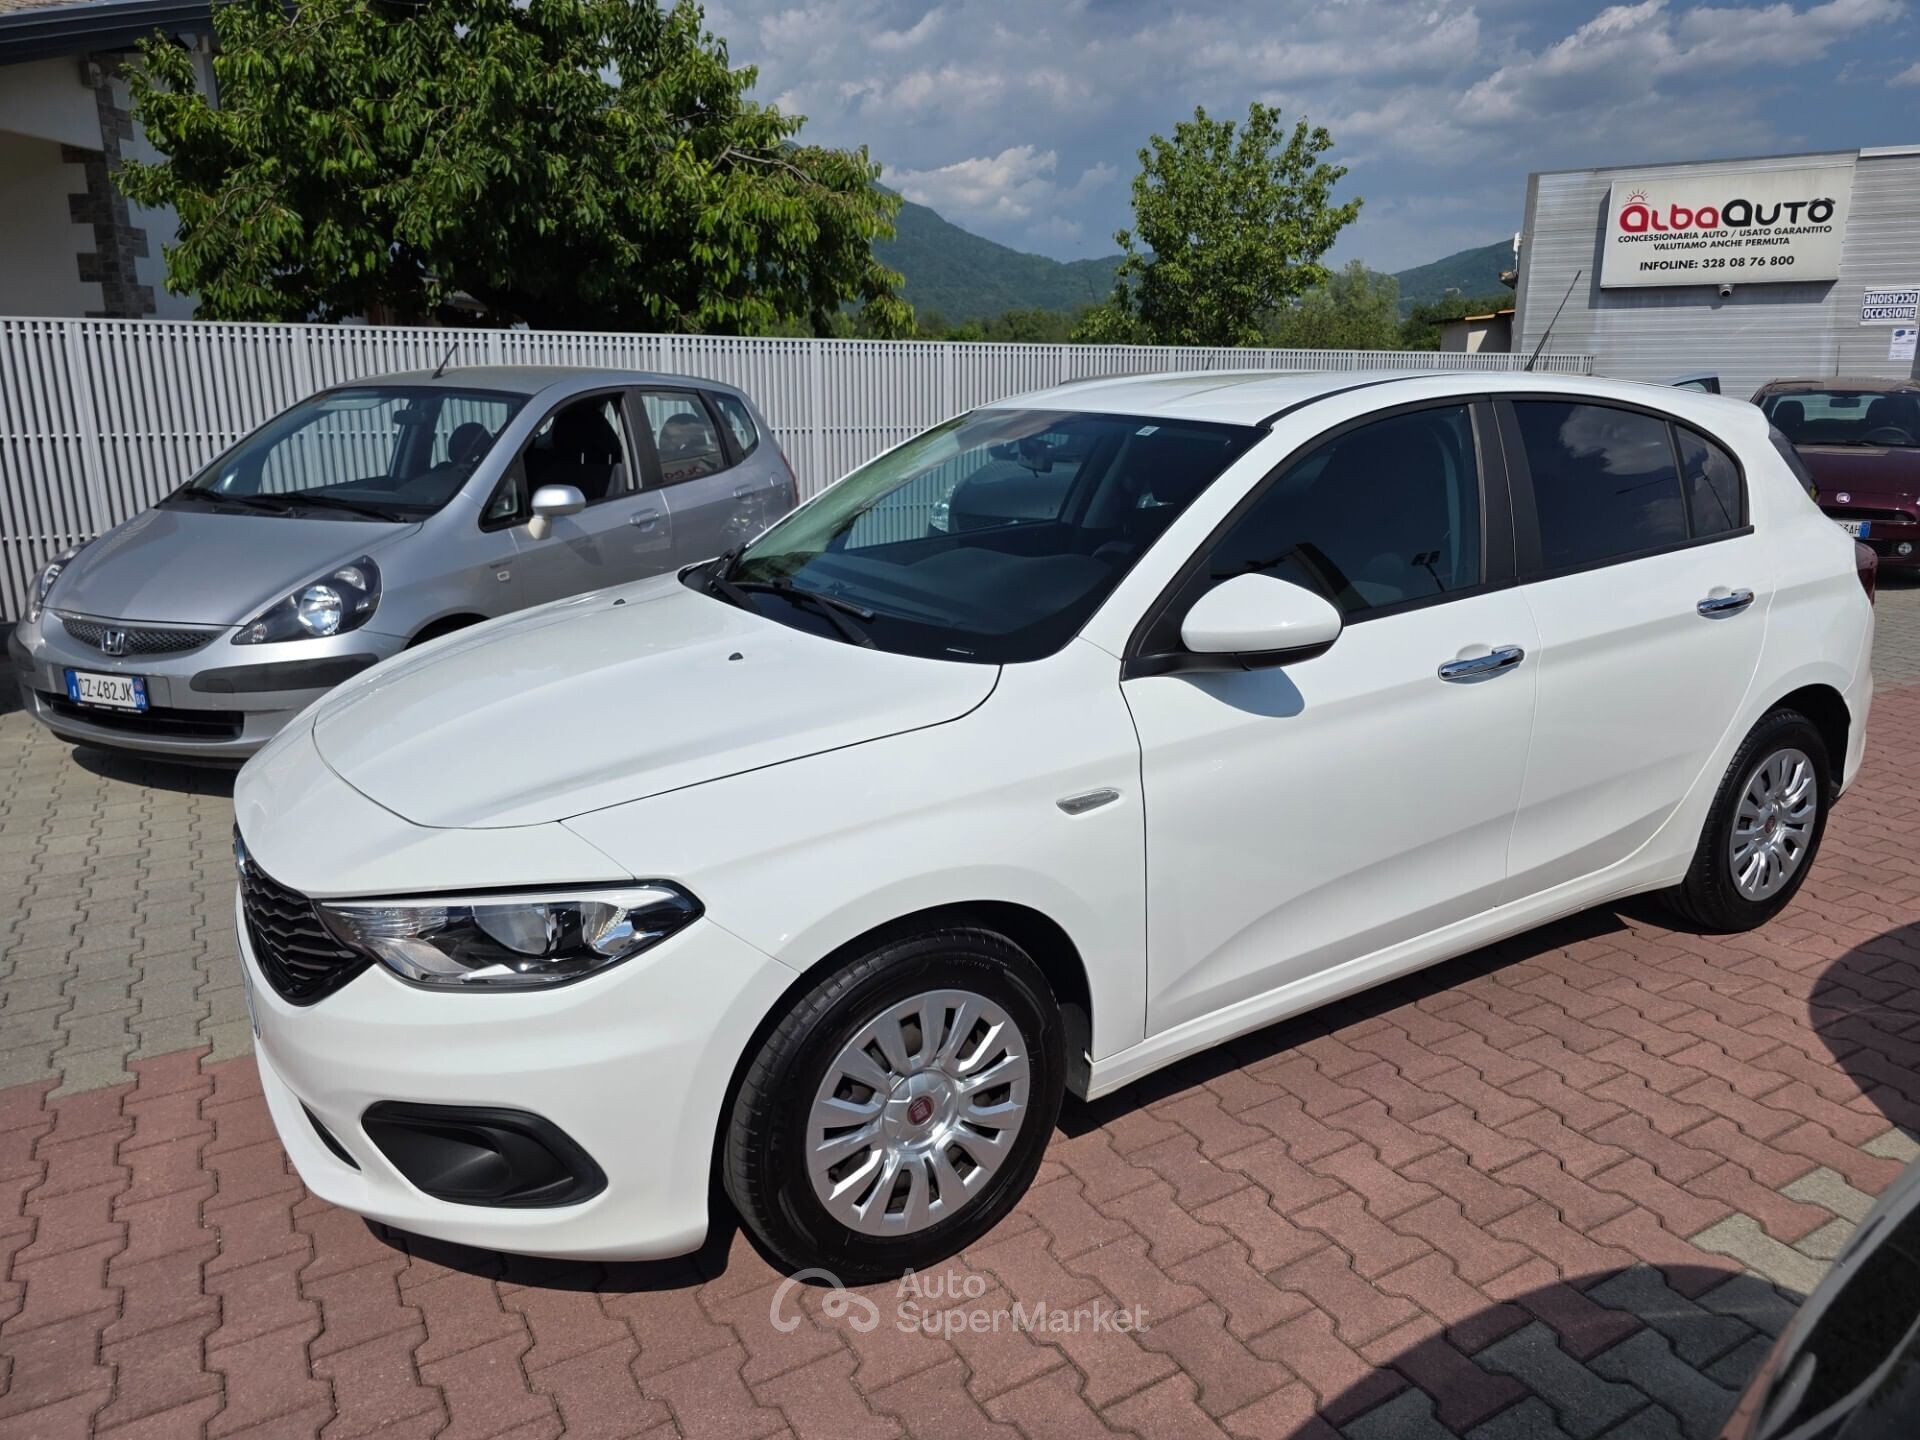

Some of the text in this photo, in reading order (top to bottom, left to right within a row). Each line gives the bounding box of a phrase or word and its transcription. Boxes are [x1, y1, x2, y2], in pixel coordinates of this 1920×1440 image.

[1617, 232, 1699, 243] CONCESSIONARIA
[1702, 230, 1728, 239] AUTO
[1739, 228, 1771, 237] USATO
[1774, 225, 1832, 235] GARANTITO
[1653, 237, 1790, 251] VALUTIAMO ANCHE PERMUTA
[1640, 255, 1795, 271] INFOLINE: 328 08 76 800
[1863, 307, 1915, 319] OCCASIONE
